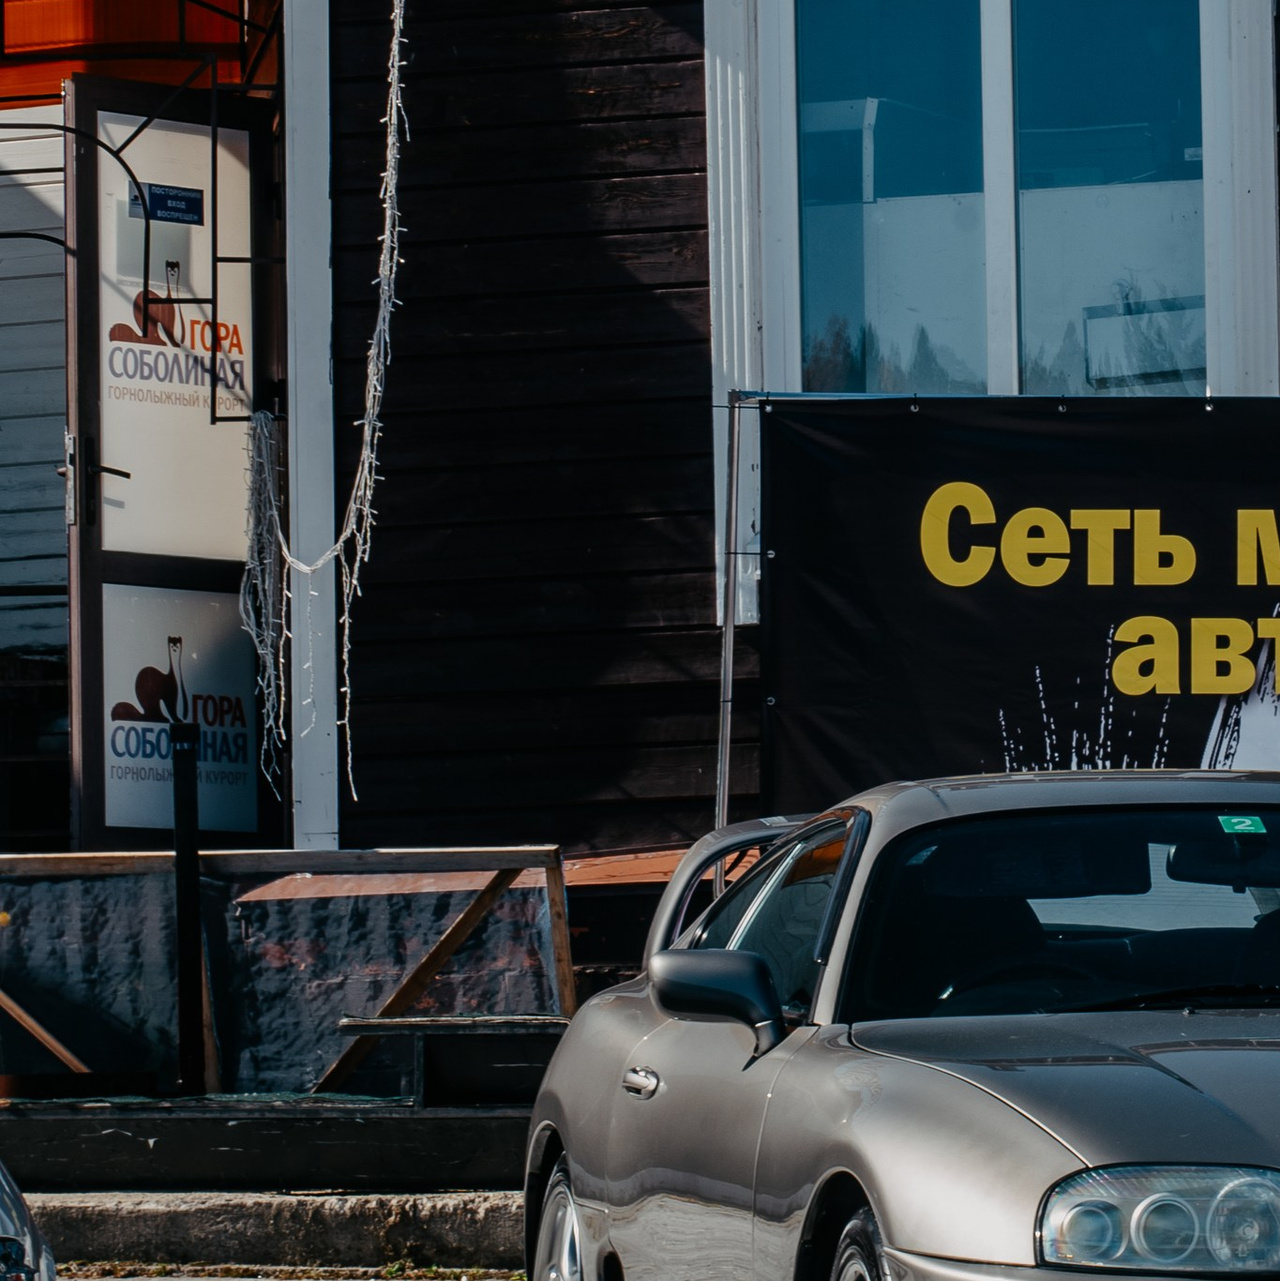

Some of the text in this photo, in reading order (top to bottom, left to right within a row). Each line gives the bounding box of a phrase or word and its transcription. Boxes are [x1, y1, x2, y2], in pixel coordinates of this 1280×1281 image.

[167, 200, 187, 209] ВХОД
[190, 319, 244, 355] ГОРА
[108, 385, 245, 412] ГОРНОЛЫЖНЫЙ КРОРТ
[920, 481, 1197, 587] Сеть
[191, 694, 247, 728] ГОРА
[111, 725, 248, 764] СОБОНАЯ
[1231, 818, 1255, 830] 2
